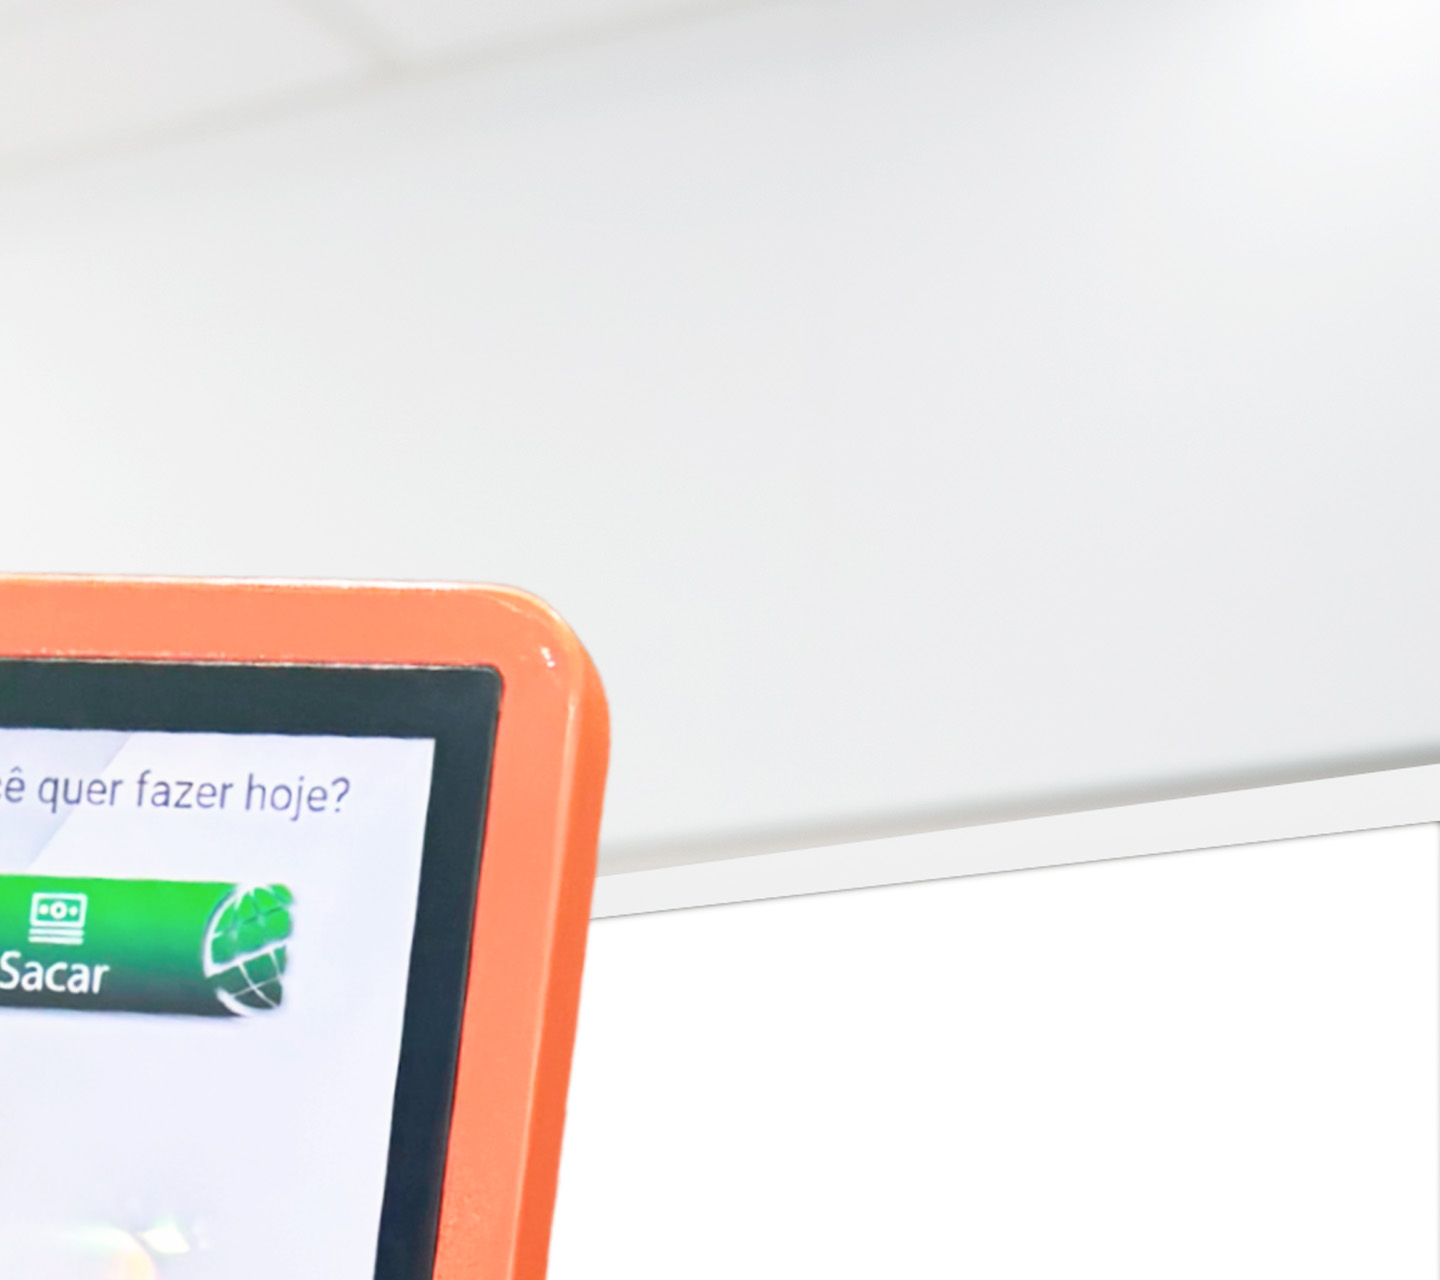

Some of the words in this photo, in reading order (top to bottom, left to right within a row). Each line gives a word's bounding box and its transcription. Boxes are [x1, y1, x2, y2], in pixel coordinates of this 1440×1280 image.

[37, 776, 124, 815] quer
[136, 769, 235, 811] fazer
[244, 772, 351, 823] hoje?
